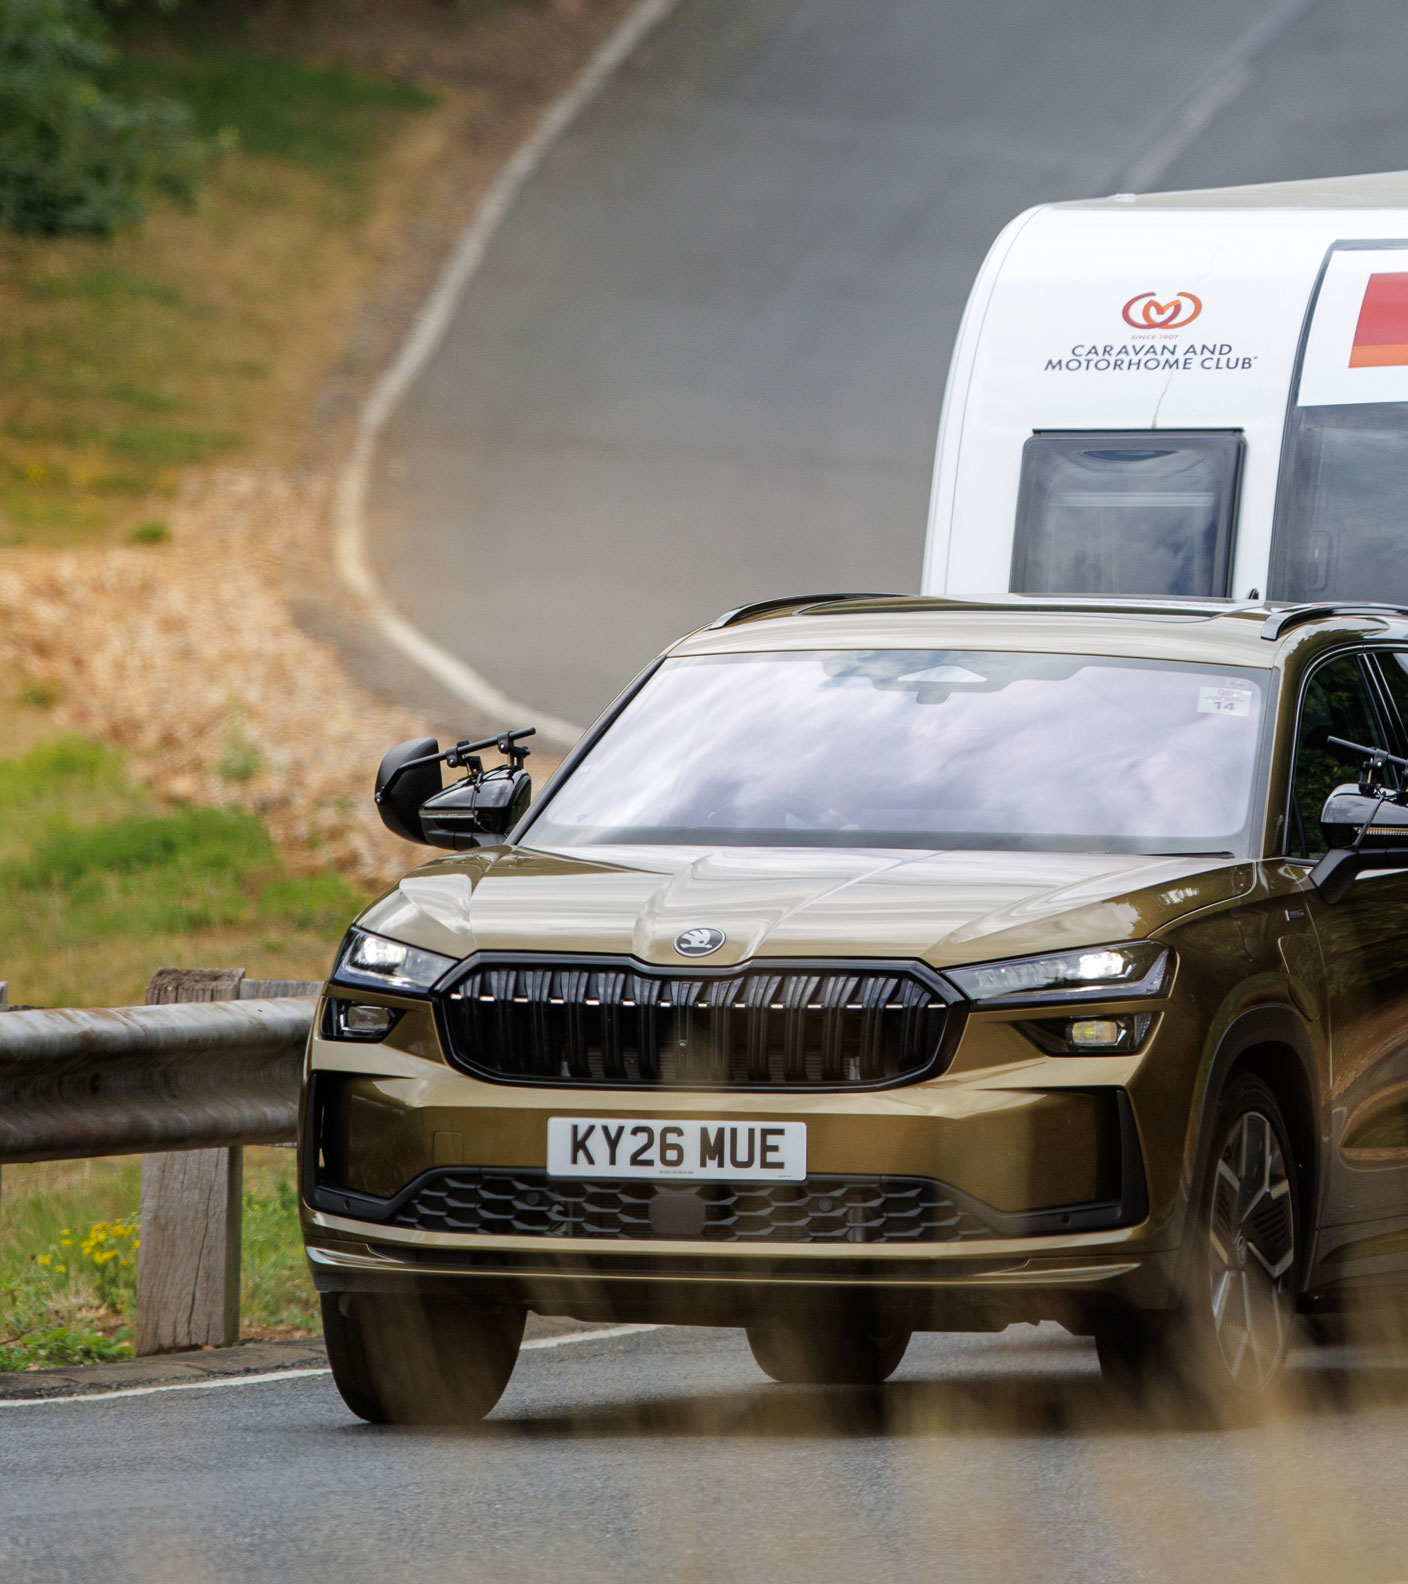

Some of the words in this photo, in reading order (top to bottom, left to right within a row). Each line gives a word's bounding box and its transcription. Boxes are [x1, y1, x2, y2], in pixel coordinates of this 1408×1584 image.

[1071, 344, 1177, 357] CARAVAN
[1183, 343, 1232, 355] AND
[1044, 358, 1193, 371] MOTORHOME
[1200, 357, 1253, 370] CLUB
[1214, 701, 1235, 711] 14
[570, 1124, 684, 1167] KY26
[699, 1126, 785, 1169] MUE
